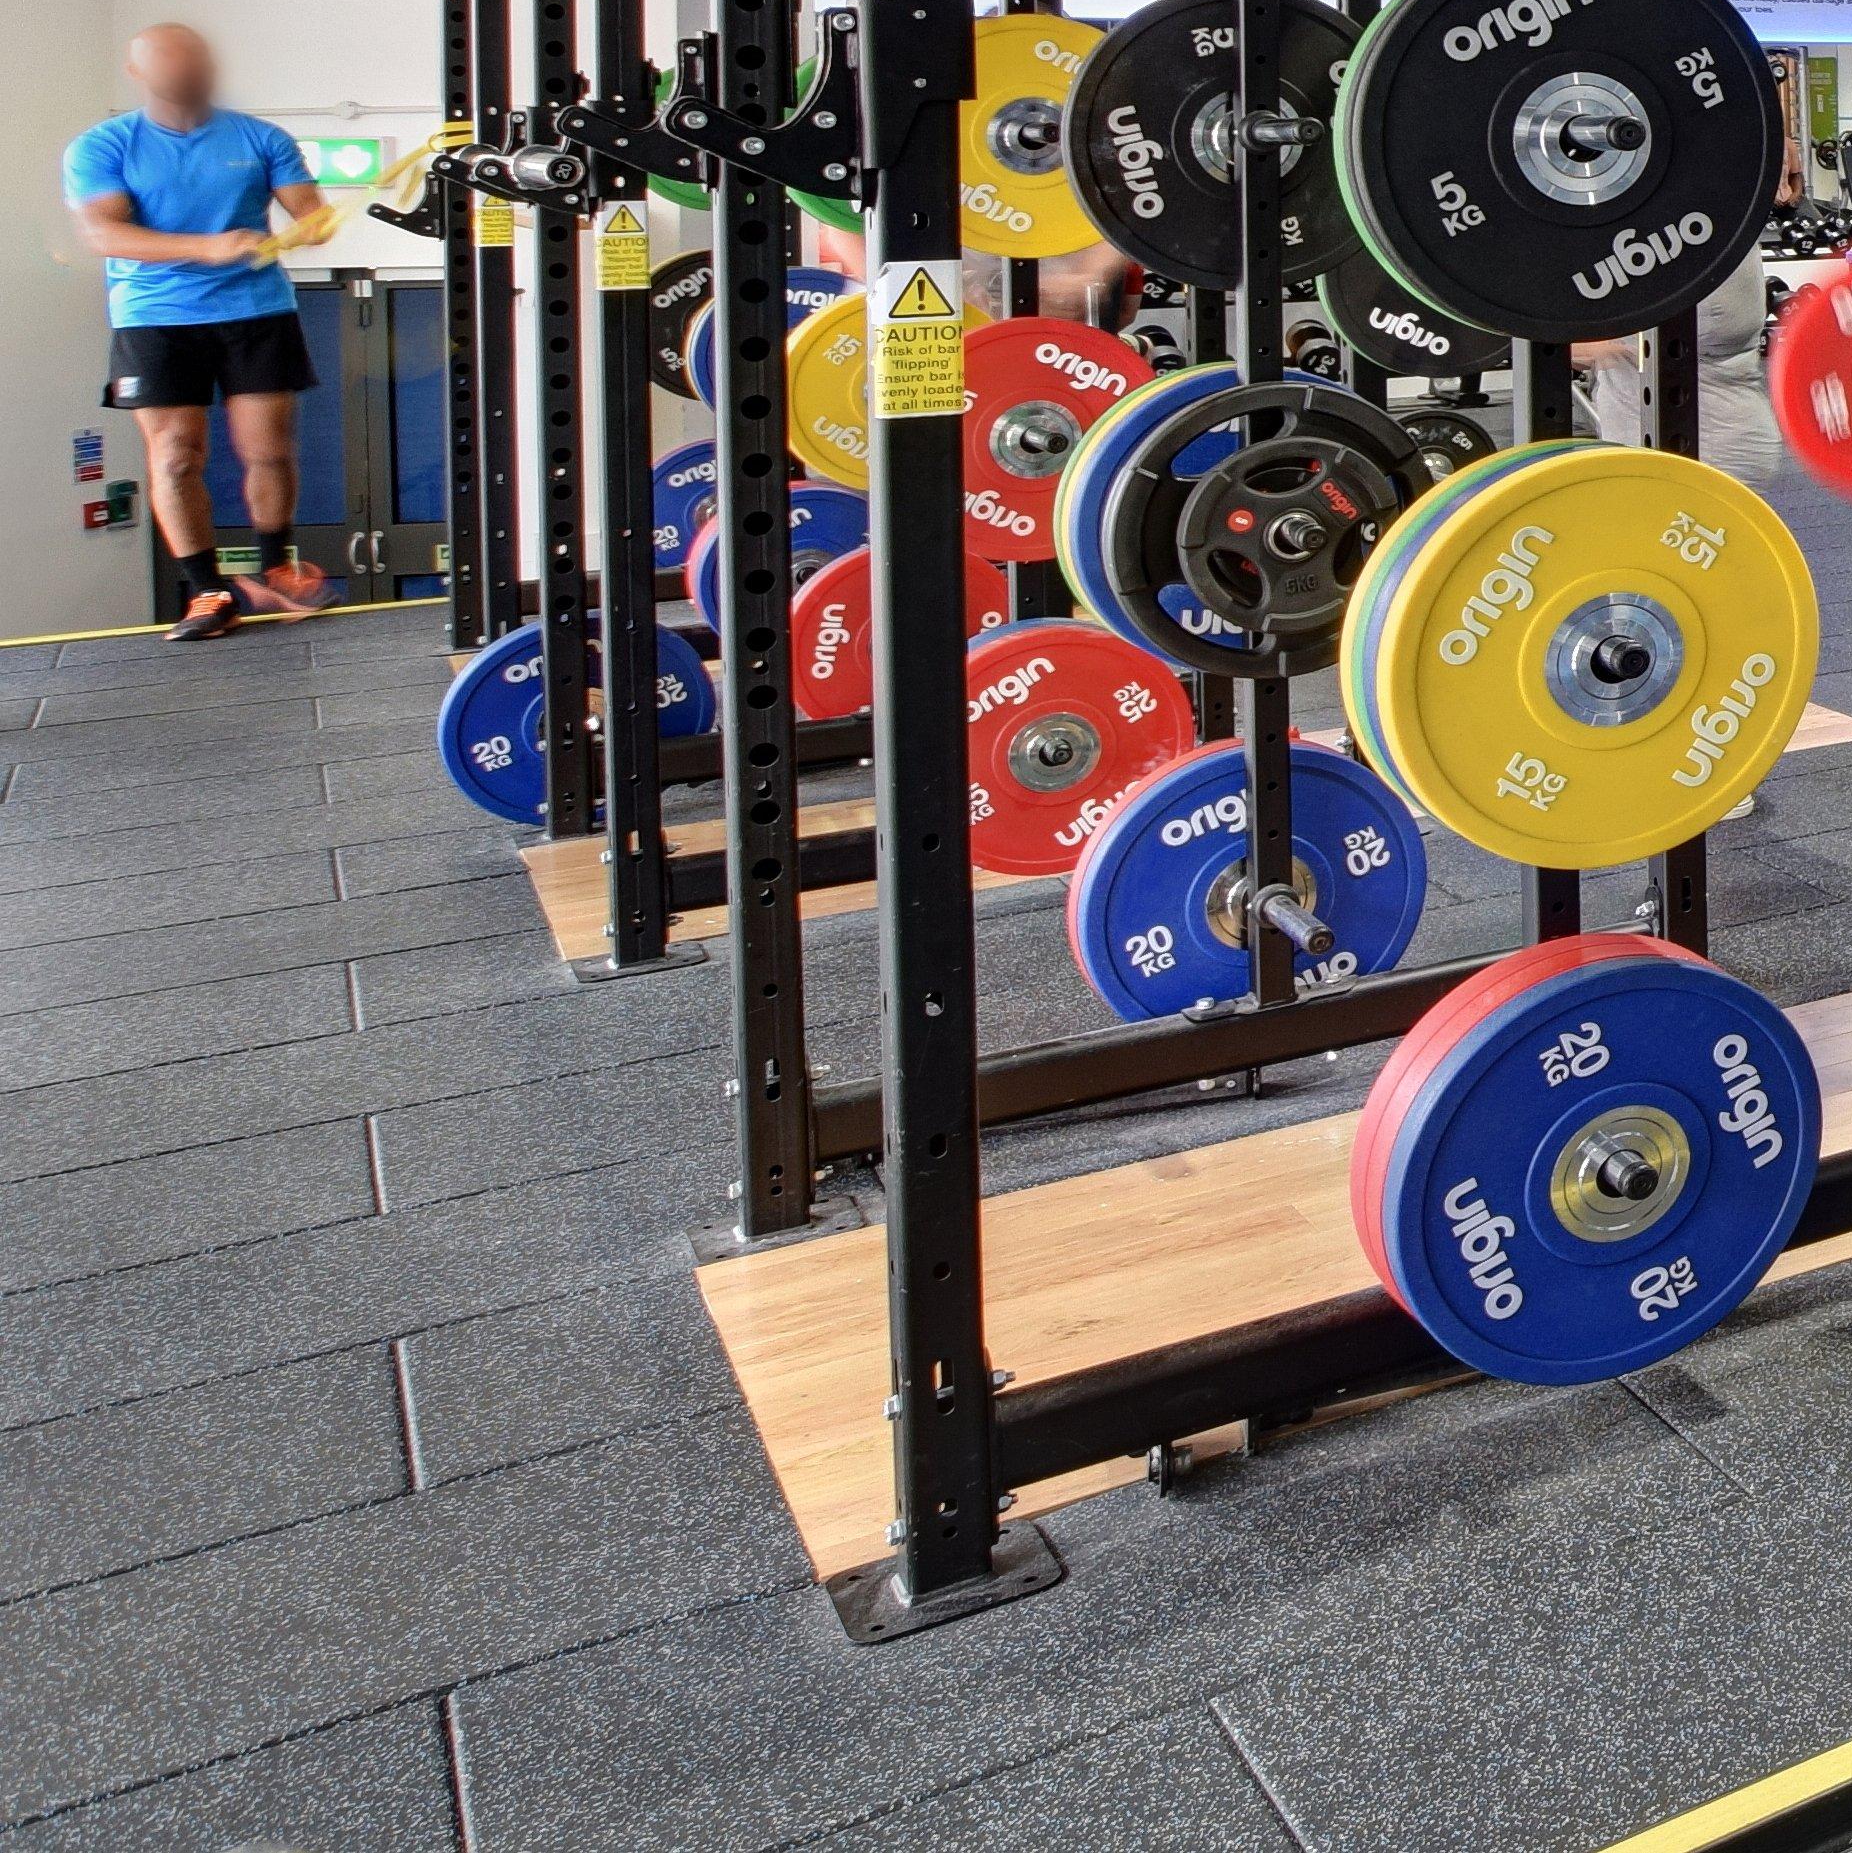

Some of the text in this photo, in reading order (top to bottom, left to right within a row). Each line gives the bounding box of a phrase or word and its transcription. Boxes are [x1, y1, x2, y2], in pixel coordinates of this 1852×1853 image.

[1674, 46, 1716, 78] KG
[1691, 68, 1725, 110] 5
[556, 163, 573, 180] 20
[1107, 105, 1165, 220] origin
[1429, 169, 1468, 212] 5
[1442, 203, 1487, 238] KG
[1570, 210, 1714, 301] origin
[653, 267, 713, 309] origin
[883, 344, 961, 357] Risk of bar
[1369, 306, 1451, 356] origin
[660, 347, 678, 363] 5
[1034, 342, 1127, 397] origin
[924, 384, 963, 395] loade
[930, 371, 953, 382] bar
[883, 398, 961, 411] at all times
[1319, 478, 1359, 520] origin
[652, 525, 679, 545] 20
[1659, 510, 1696, 549] KG
[1679, 525, 1727, 571] 15
[1438, 524, 1556, 666] origin
[811, 603, 851, 680] origin
[1112, 680, 1144, 704] KG
[1118, 687, 1158, 725] 25
[1670, 652, 1777, 788] origin
[472, 735, 512, 765] 20
[484, 755, 513, 773] KG
[1495, 750, 1549, 801] 15
[1529, 772, 1568, 813] KG
[1160, 788, 1247, 847] orig
[1343, 825, 1378, 851] KG
[1347, 835, 1391, 877] 20
[1125, 925, 1175, 967] 20
[1142, 950, 1177, 978] KG
[1539, 1044, 1570, 1088] KG
[1557, 1021, 1611, 1080] 20
[1712, 1033, 1784, 1171] origin
[1443, 1176, 1525, 1321] origin
[1629, 1265, 1681, 1323] 20
[1665, 1255, 1699, 1300] KG
